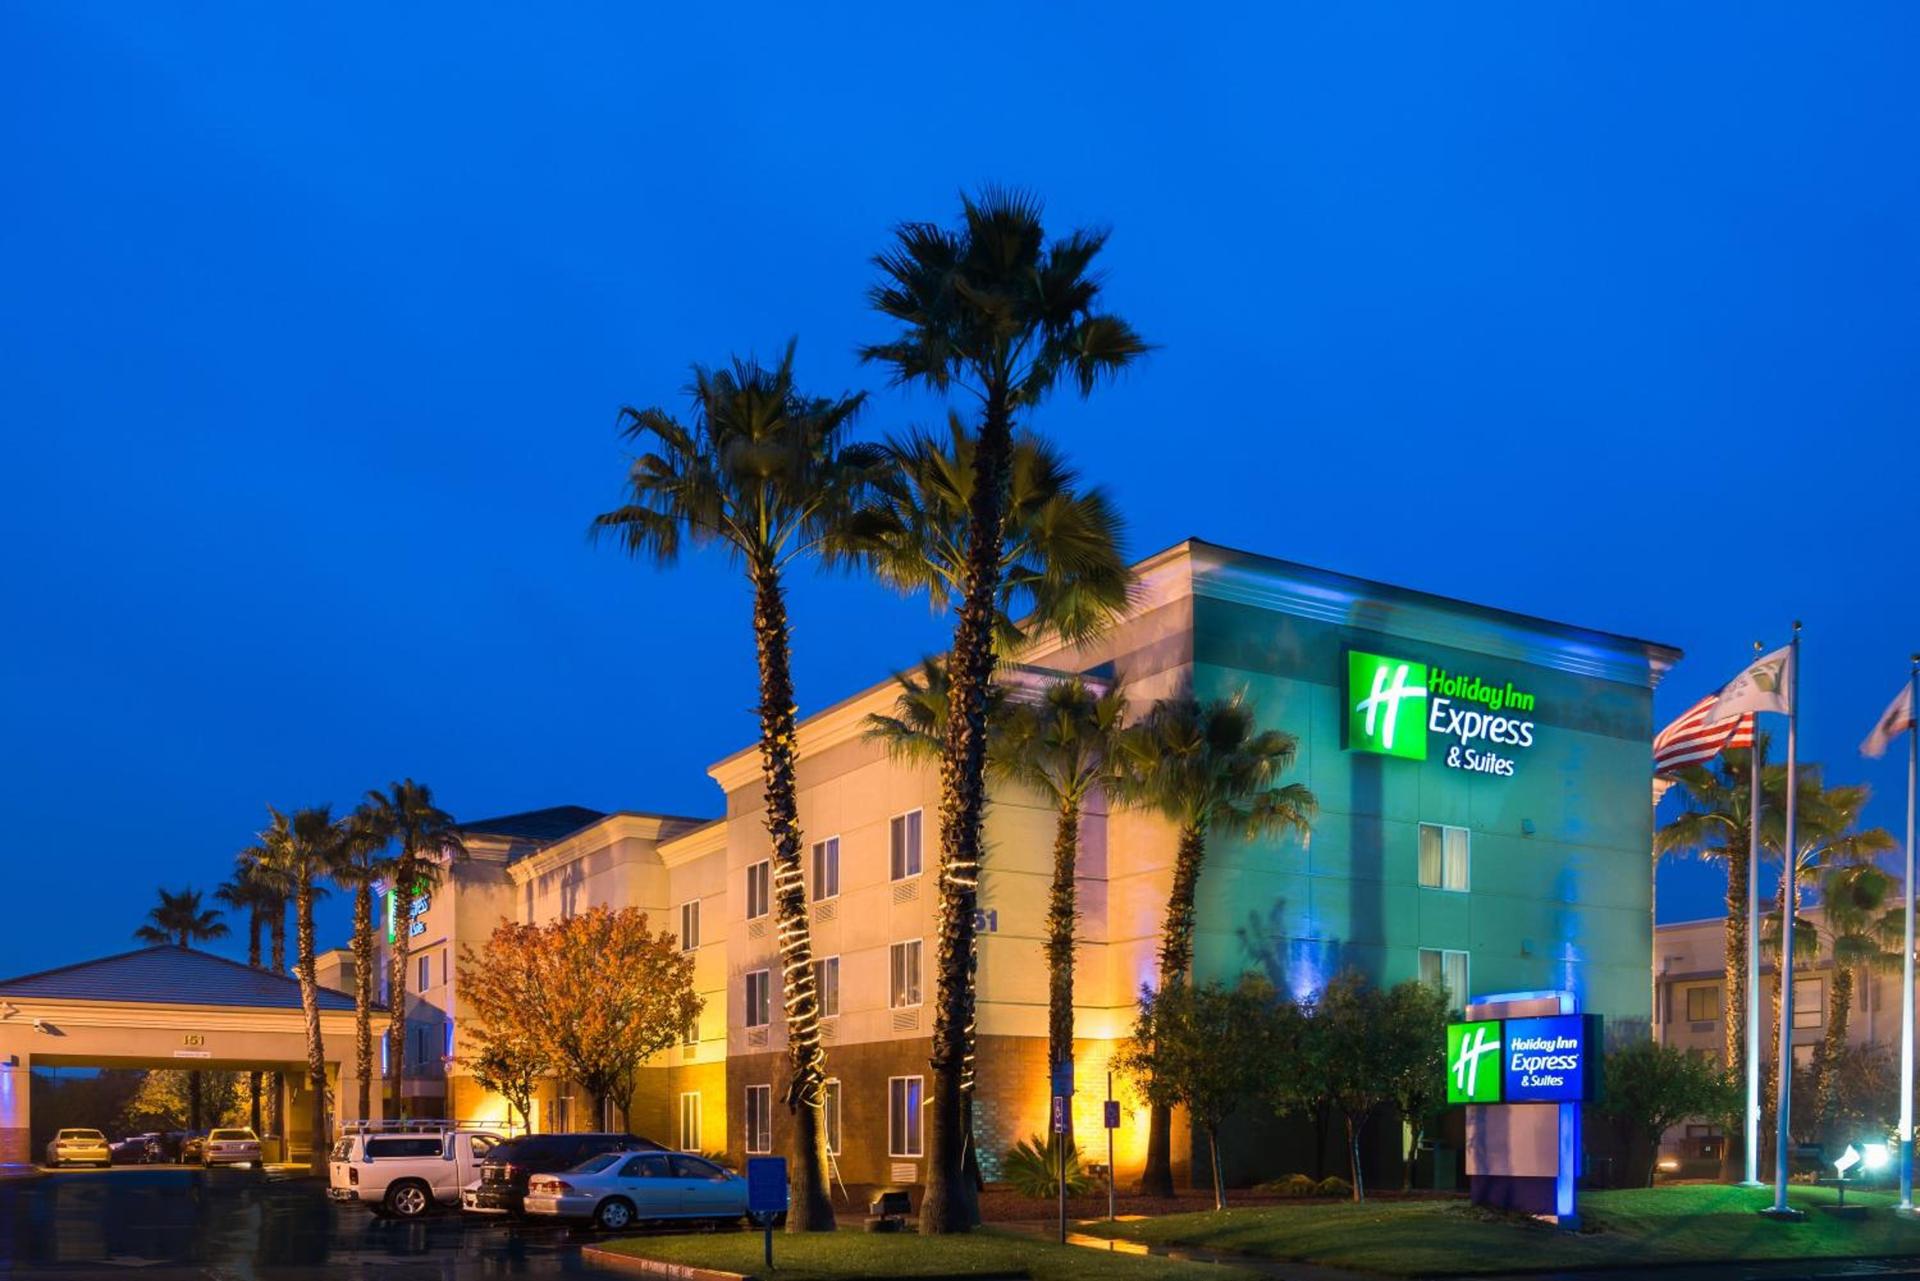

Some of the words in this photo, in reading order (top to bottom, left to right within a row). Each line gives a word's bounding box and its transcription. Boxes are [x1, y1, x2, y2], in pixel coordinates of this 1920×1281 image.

[1428, 667, 1503, 710] Holiday
[1505, 682, 1535, 711] Inn
[1429, 697, 1534, 747] Express
[1447, 746, 1461, 768] &
[1463, 749, 1515, 777] Suites
[184, 1035, 205, 1046] 151
[1511, 1036, 1556, 1052] Holiday
[1556, 1035, 1578, 1049] Inn
[1511, 1053, 1577, 1075] Express
[1521, 1075, 1529, 1087] &
[1530, 1074, 1564, 1087] Suites
